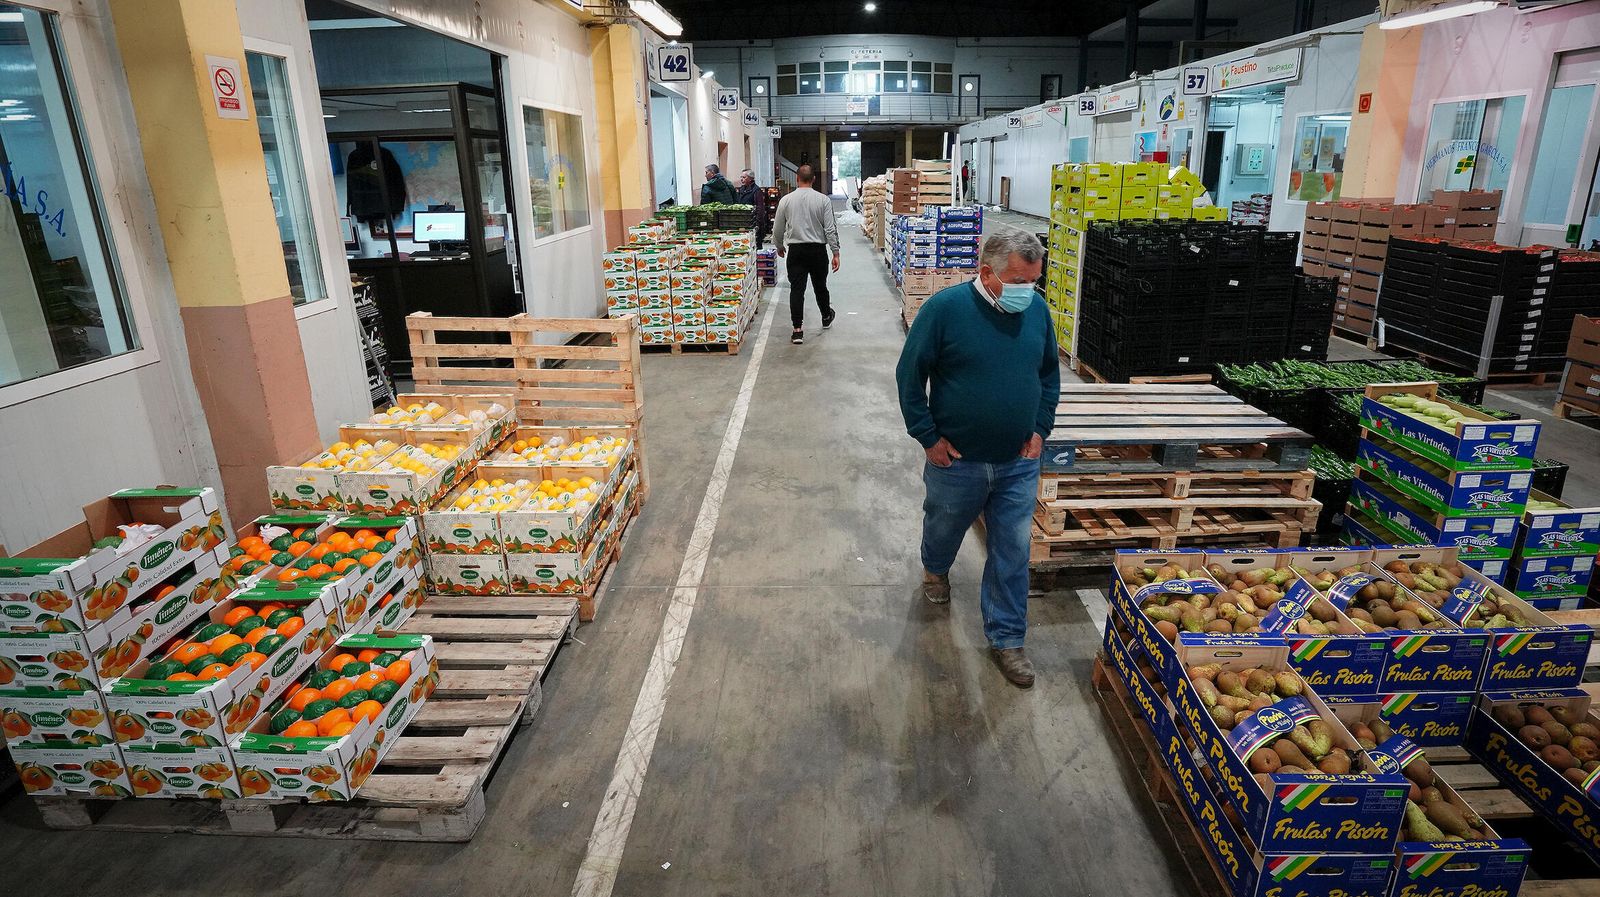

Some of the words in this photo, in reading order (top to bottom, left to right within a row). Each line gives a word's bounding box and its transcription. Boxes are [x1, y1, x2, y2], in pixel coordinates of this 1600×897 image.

[663, 55, 687, 72] 42
[1230, 61, 1258, 76] Faustino
[1187, 74, 1206, 89] 37
[719, 95, 736, 106] 43
[1081, 100, 1095, 111] 38
[745, 113, 758, 122] 44
[1009, 117, 1020, 125] 39
[35, 190, 66, 237] S.A.
[1402, 427, 1416, 439] Las
[1418, 432, 1452, 456] Virtudes
[1480, 446, 1489, 454] LAS
[1489, 446, 1512, 455] VIRTUDES
[1398, 470, 1412, 484] Las
[1414, 476, 1445, 502] Virtudes
[1388, 511, 1397, 522] La
[1410, 525, 1433, 544] rtudes
[1459, 536, 1469, 545] LAS
[1545, 533, 1556, 541] LAS
[143, 543, 173, 567] Jiménez
[137, 577, 154, 590] 100%
[153, 563, 172, 579] Calidad
[173, 556, 186, 567] Extra
[1539, 576, 1550, 584] LAS
[158, 597, 187, 623] Jiménez
[151, 630, 166, 646] 100%
[166, 618, 186, 634] Calidad
[185, 608, 199, 621] Extra
[1113, 579, 1137, 626] Frutas
[1137, 624, 1165, 669] Pisón
[1108, 629, 1129, 677] Frutas
[1130, 671, 1157, 723] Pisón
[1334, 668, 1374, 685] Pisón
[1385, 664, 1430, 681] Frutas
[1433, 662, 1472, 681] Pisón
[1490, 662, 1535, 679] Frutas
[1538, 660, 1577, 679] Pisón
[35, 714, 64, 723] Jiménez
[1259, 711, 1286, 726] Pisón
[1421, 721, 1460, 738] Pisón
[1176, 678, 1208, 745] Frutas
[1210, 738, 1249, 813] Pisón
[1486, 732, 1552, 801] Frutas
[1168, 736, 1200, 806] Frutas
[1201, 800, 1239, 879] Pisón
[1272, 818, 1331, 841] Frutas
[1334, 818, 1389, 840] Pisón
[1463, 841, 1500, 850] Frutas
